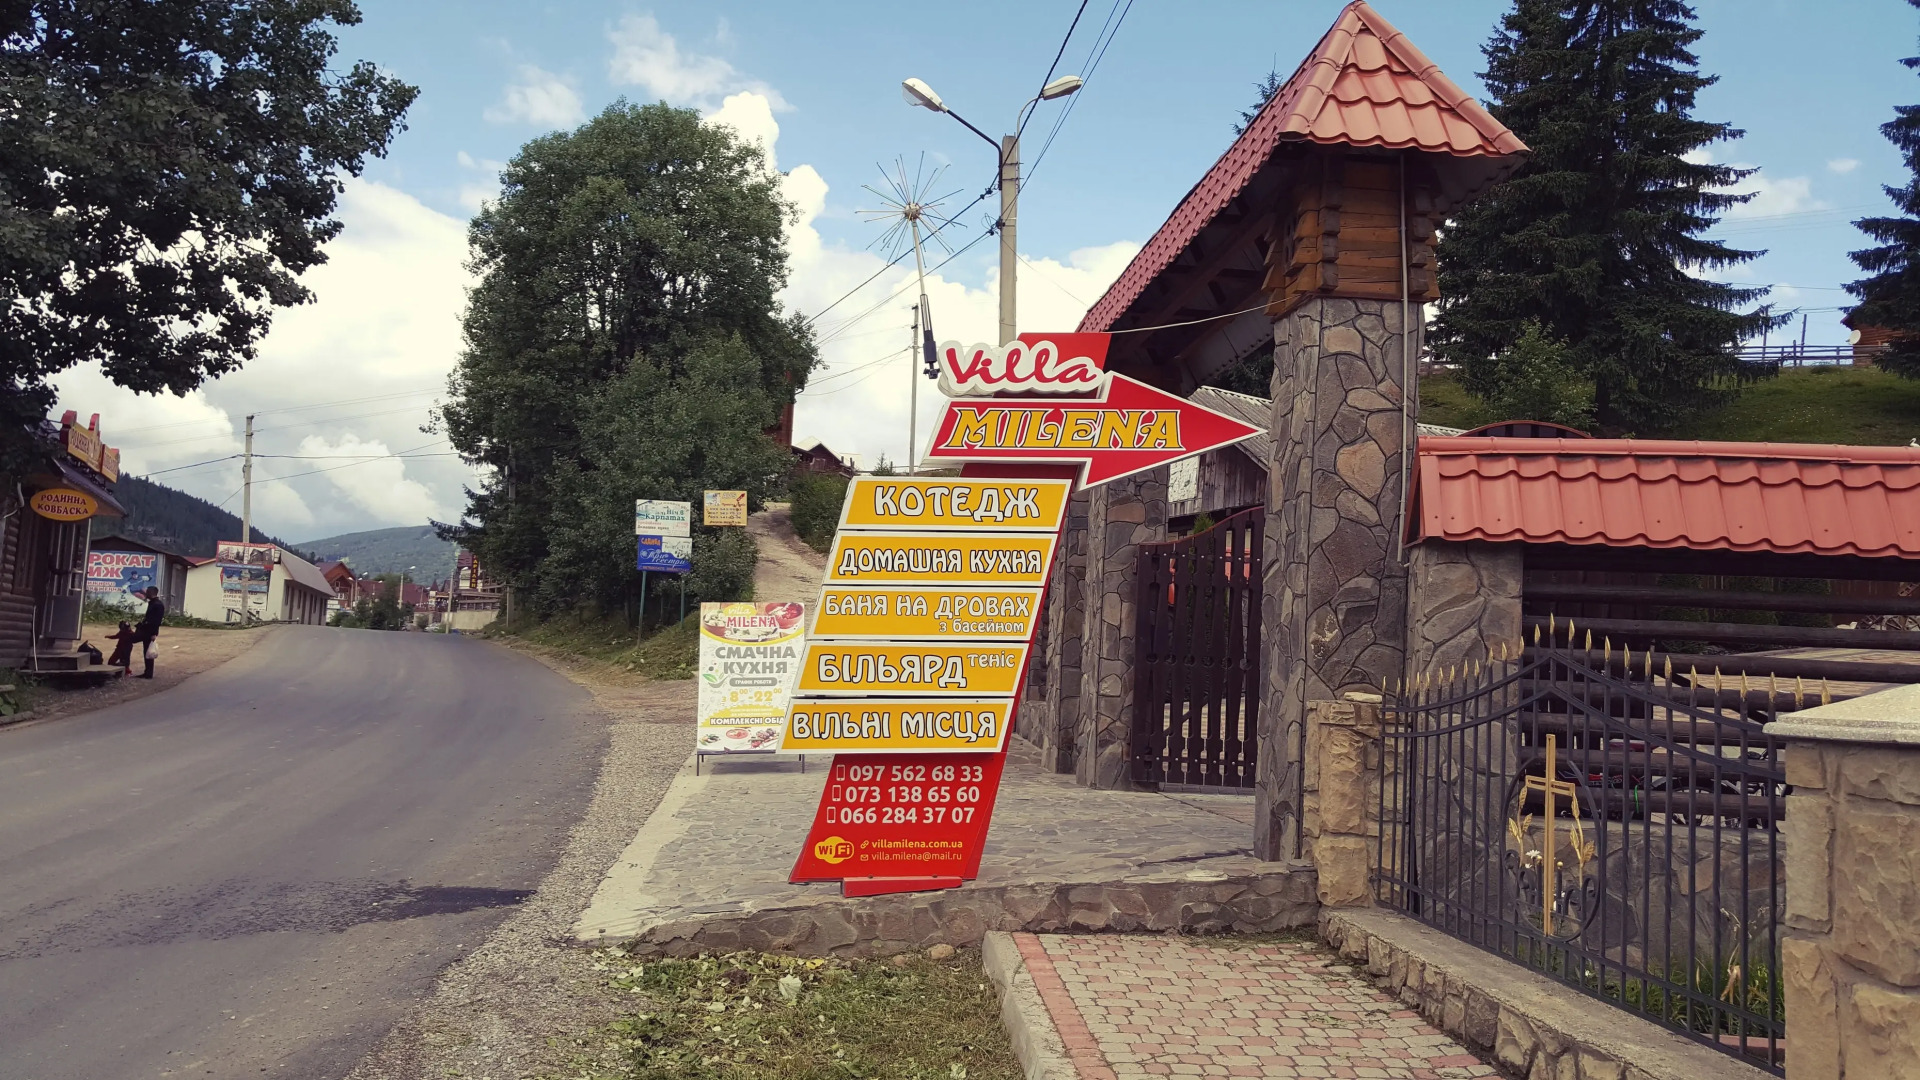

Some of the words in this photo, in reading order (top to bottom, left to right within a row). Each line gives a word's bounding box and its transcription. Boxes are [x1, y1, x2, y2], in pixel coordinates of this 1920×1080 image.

[946, 347, 1097, 384] Villa
[944, 408, 1184, 450] MILENA
[41, 494, 87, 505] РОДИННА
[874, 486, 1040, 522] КОТЕДЖ
[37, 503, 89, 515] КОВБАСКА
[645, 513, 686, 521] Карпатах
[89, 552, 155, 568] РОКАТ
[838, 548, 962, 576] ДОМАШНЯ
[969, 550, 1042, 573] КУХНЯ
[88, 566, 123, 579] ИЖ
[825, 594, 888, 616] БАНЯ
[896, 594, 928, 616] НА
[934, 596, 1030, 619] ДРОВАХ
[726, 616, 777, 628] MILENA
[939, 621, 947, 633] з
[952, 618, 1024, 633] басейном
[715, 646, 797, 659] СМАЧНА
[967, 650, 1015, 668] теніс
[723, 661, 788, 674] КУХНЯ
[818, 654, 967, 688] БІЛЬЯРД
[710, 716, 763, 725] КОМПЛЕКСНІ
[764, 716, 784, 725] ОБІД
[792, 712, 891, 739] ВІЛЬНІ
[901, 711, 996, 743] МІСЦЯ
[850, 765, 885, 782] 097
[891, 765, 926, 782] 562
[931, 765, 955, 782] 68
[960, 765, 983, 782] 33
[845, 786, 881, 803] 073
[888, 786, 922, 803] 138
[927, 786, 950, 803] 65
[956, 786, 980, 803] 60
[840, 807, 877, 824] 066
[882, 807, 917, 824] 284
[923, 807, 946, 824] 37
[951, 807, 975, 824] 07
[872, 839, 963, 848] villamilena.com.ua
[872, 851, 962, 861] villa.milena@mail.ru
